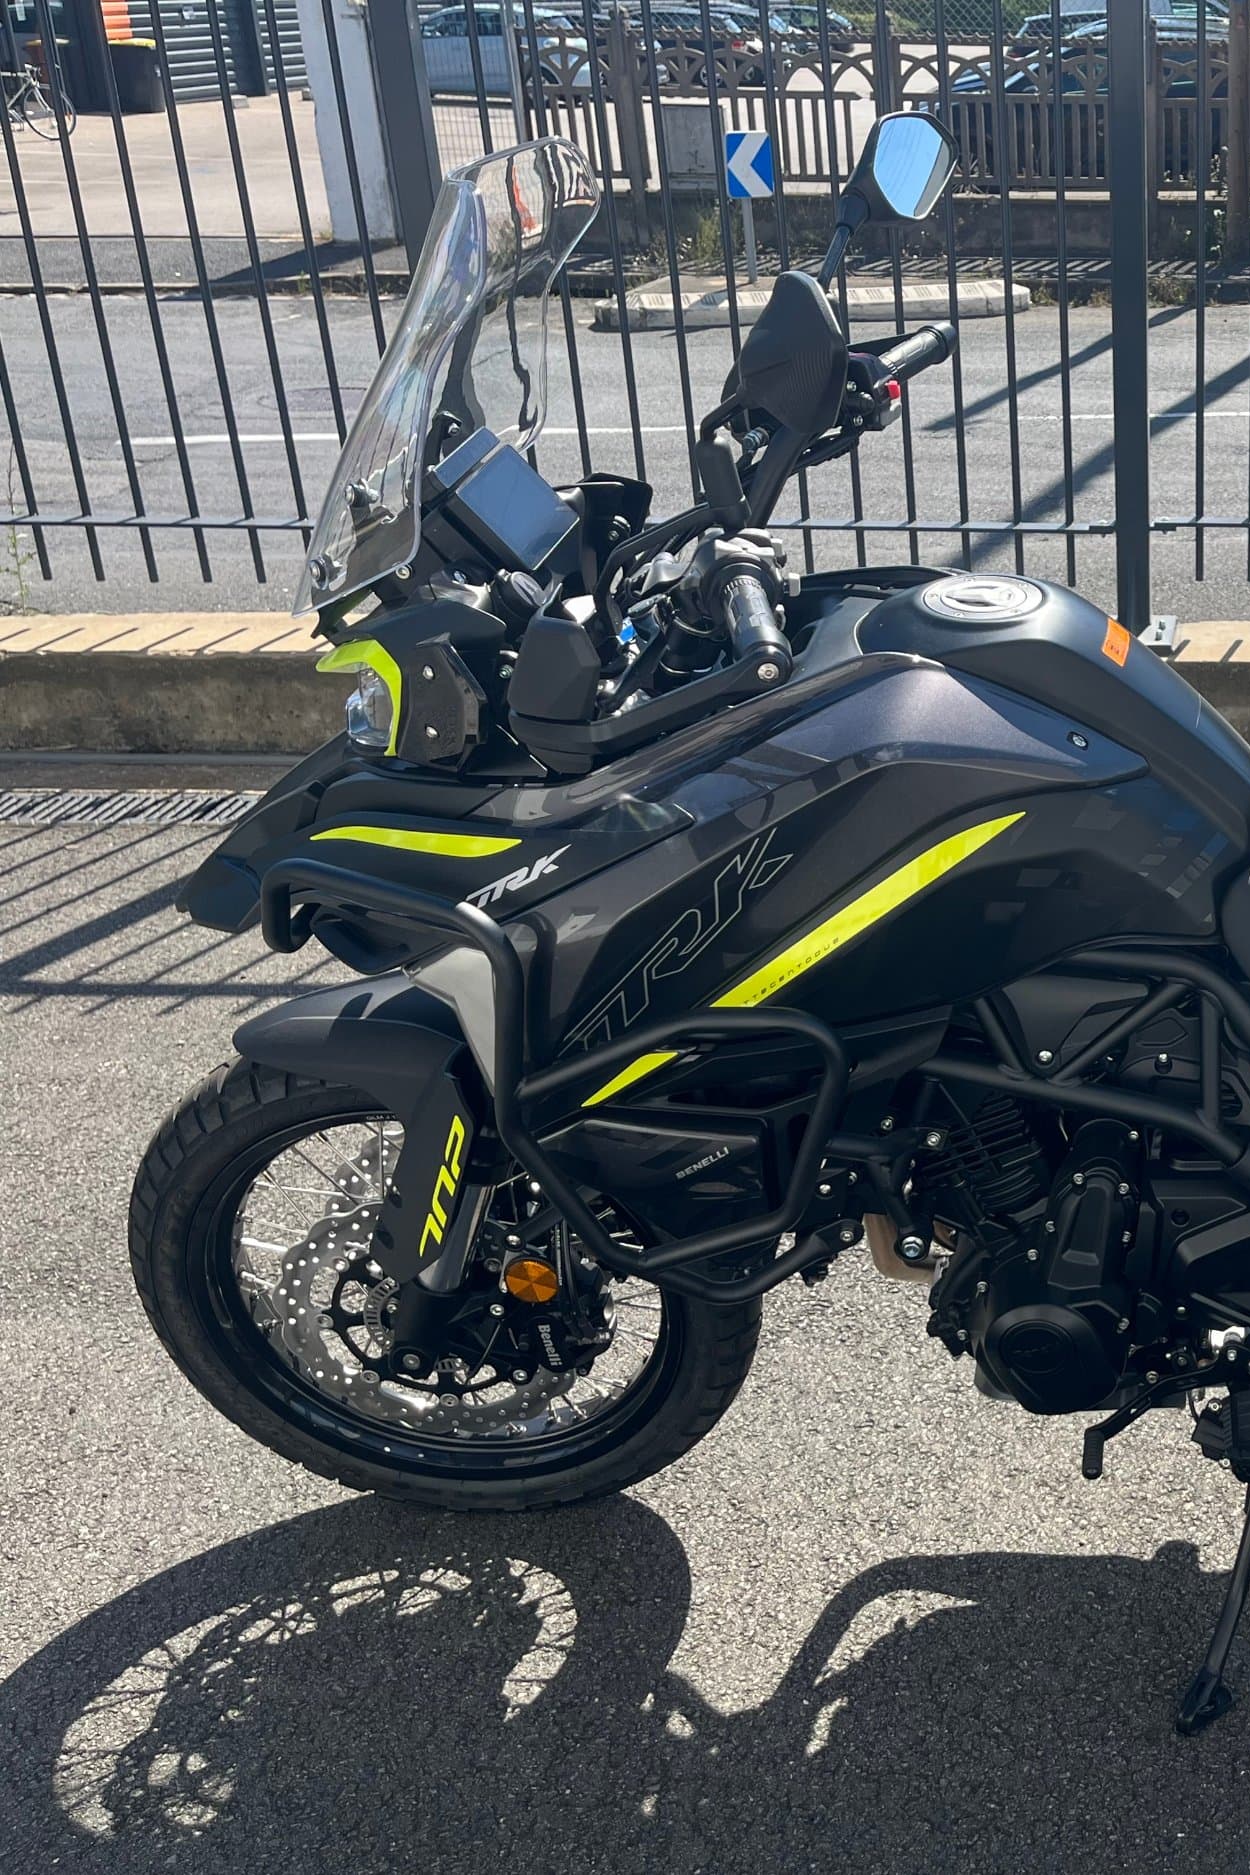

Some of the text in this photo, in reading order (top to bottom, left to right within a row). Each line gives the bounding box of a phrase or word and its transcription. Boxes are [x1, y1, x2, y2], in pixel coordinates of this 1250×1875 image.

[465, 843, 572, 908] TRK
[675, 1146, 729, 1180] BENELLI
[537, 1324, 563, 1367] Benelli
